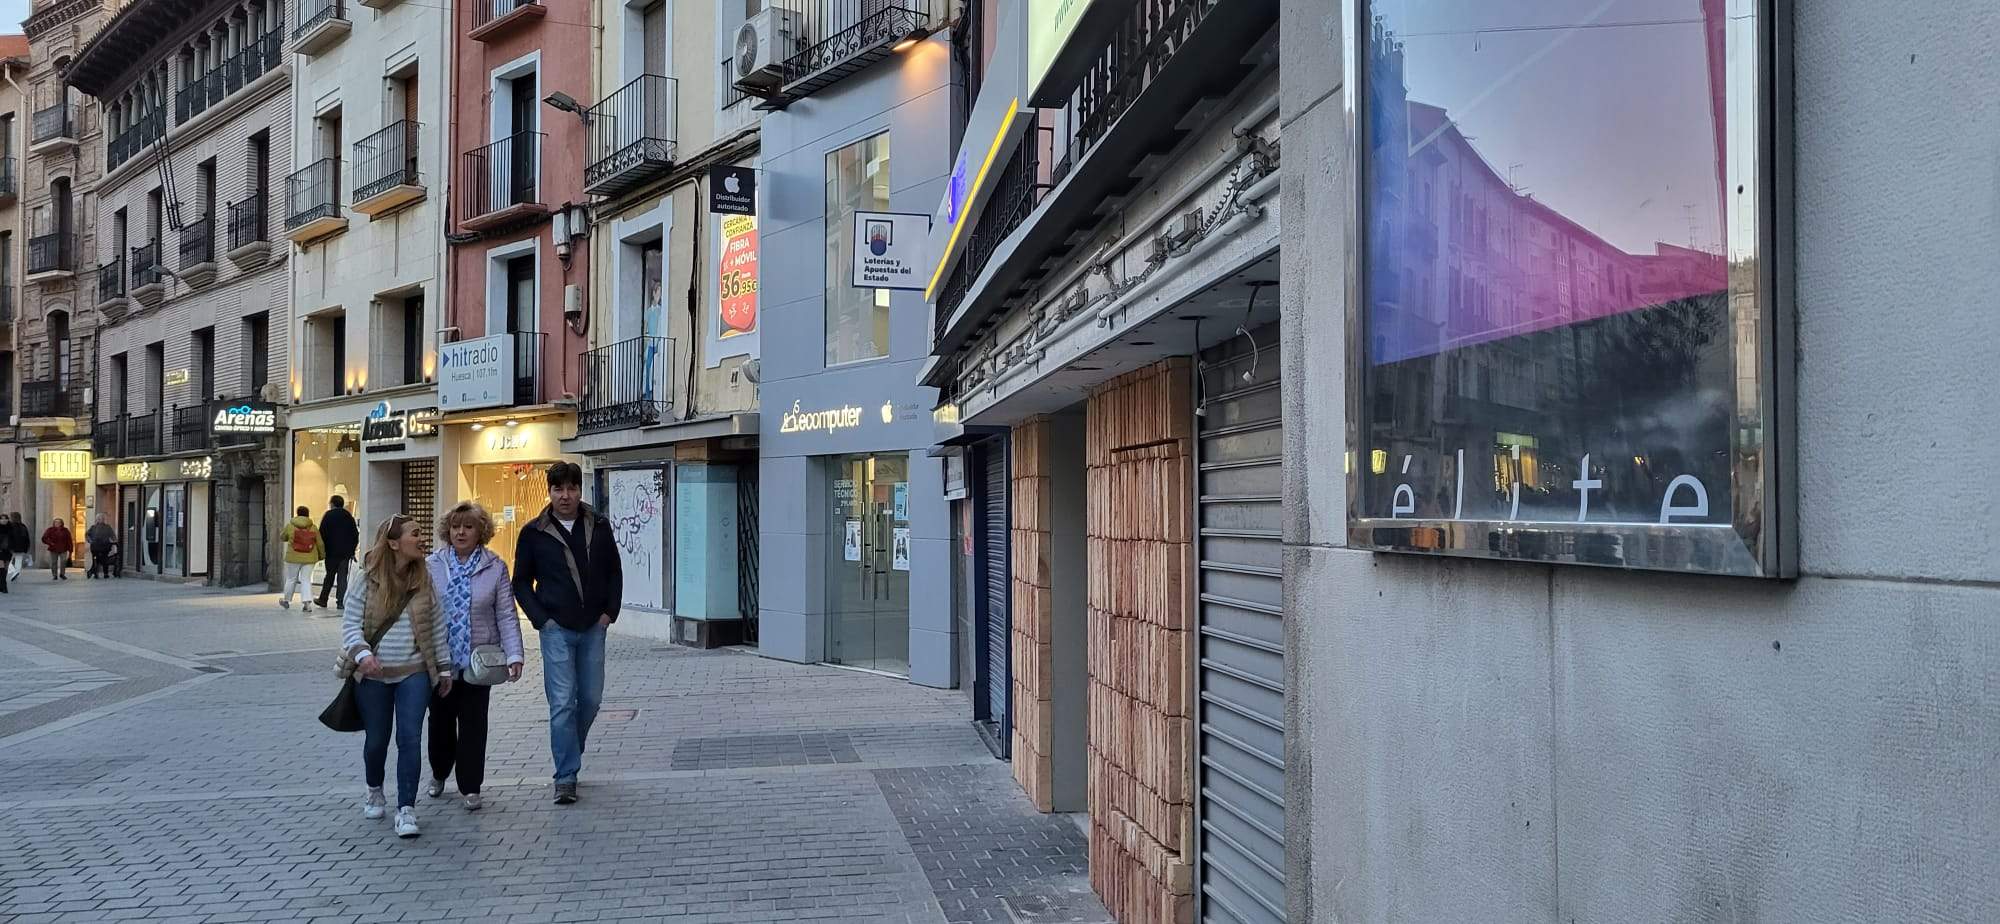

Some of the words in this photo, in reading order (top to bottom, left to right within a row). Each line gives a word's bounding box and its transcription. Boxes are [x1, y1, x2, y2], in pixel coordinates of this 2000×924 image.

[715, 193, 751, 204] Distribuidor
[716, 203, 749, 212] autorizado
[725, 220, 754, 238] CONFIANZA
[730, 237, 750, 254] FIBRA
[735, 249, 757, 266] MÓVIL
[864, 256, 895, 265] Loterías
[896, 259, 901, 267] y
[863, 273, 889, 281] Estado
[864, 265, 899, 274] Apuestas
[900, 266, 912, 274] del
[452, 341, 498, 368] hitradio
[451, 370, 471, 381] Huesca
[214, 410, 275, 426] Arenas
[798, 403, 863, 435] ecomputer
[43, 453, 87, 473] ASCASO
